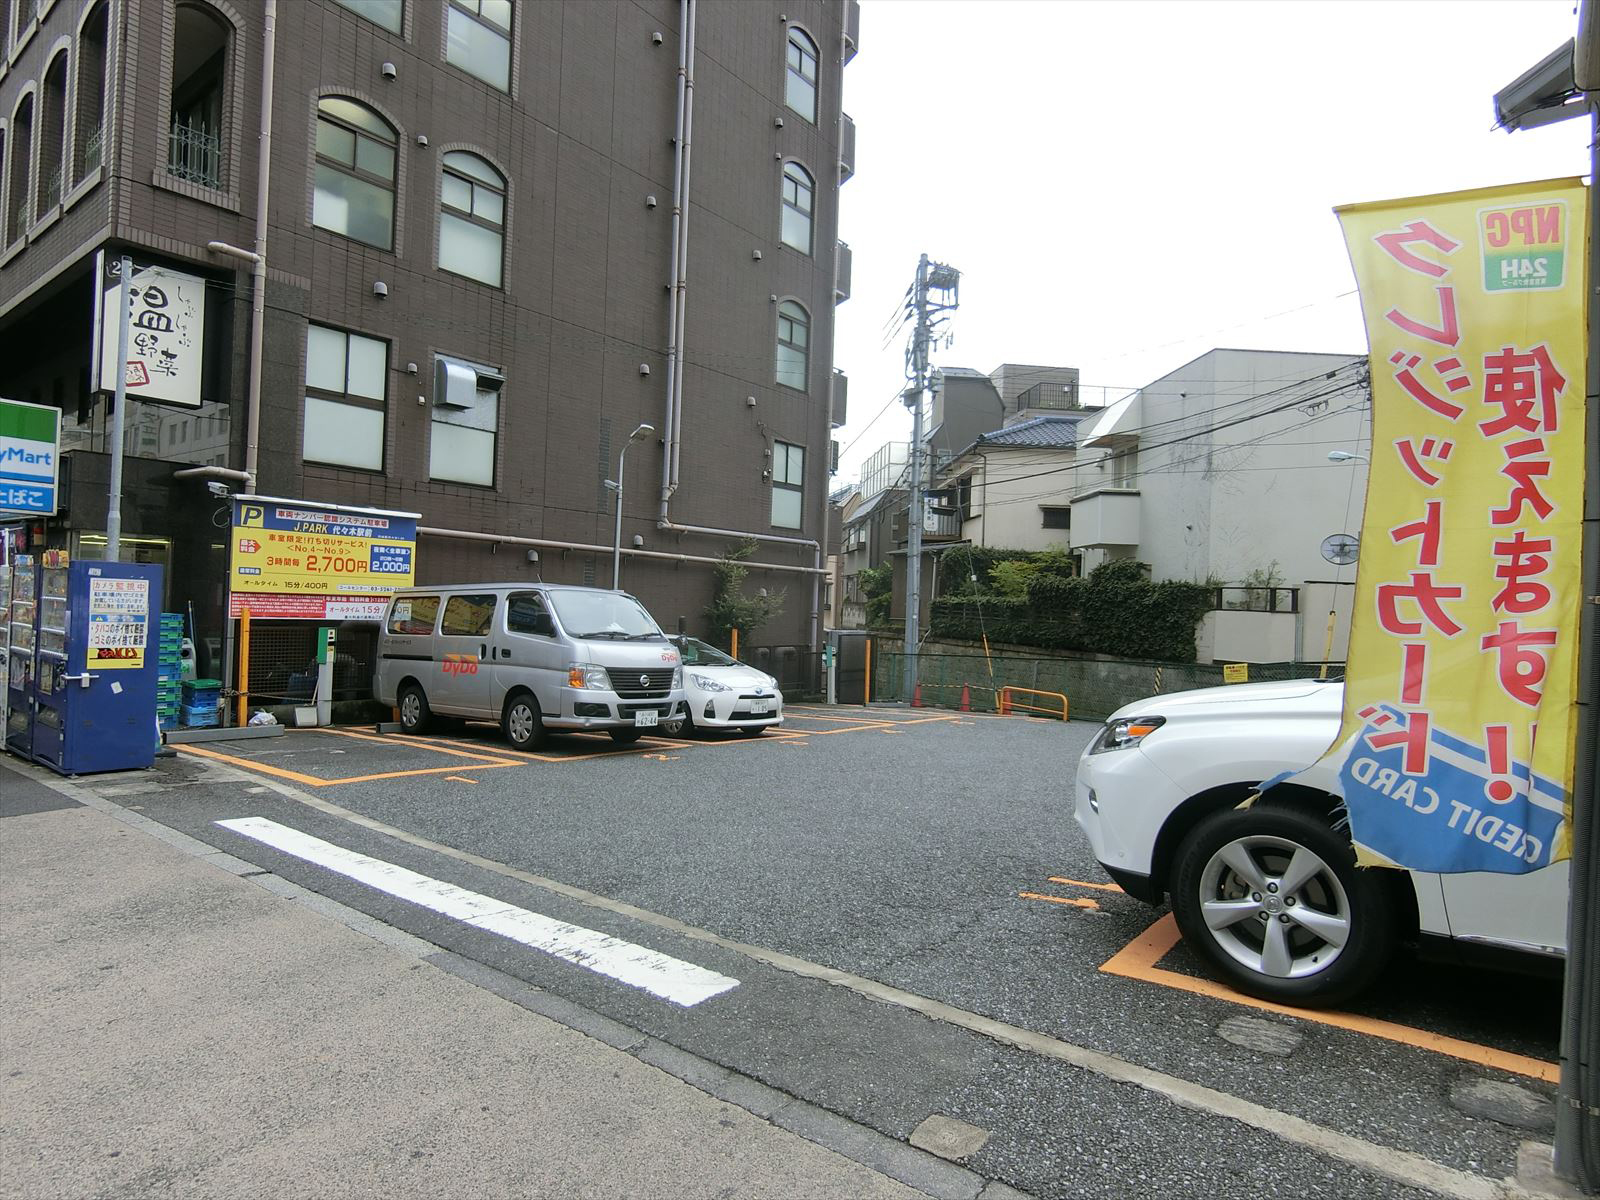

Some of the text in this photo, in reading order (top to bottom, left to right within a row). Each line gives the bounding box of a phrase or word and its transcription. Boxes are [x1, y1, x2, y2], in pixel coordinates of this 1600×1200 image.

[0, 447, 51, 466] yMart
[242, 506, 262, 525] P
[294, 522, 373, 538] J.PARK 代々木駅前
[266, 555, 368, 573] 3時間毎 2,700円
[372, 561, 410, 572] 2,000円
[284, 581, 328, 589] 15分/400円
[442, 657, 478, 678] DyDo
